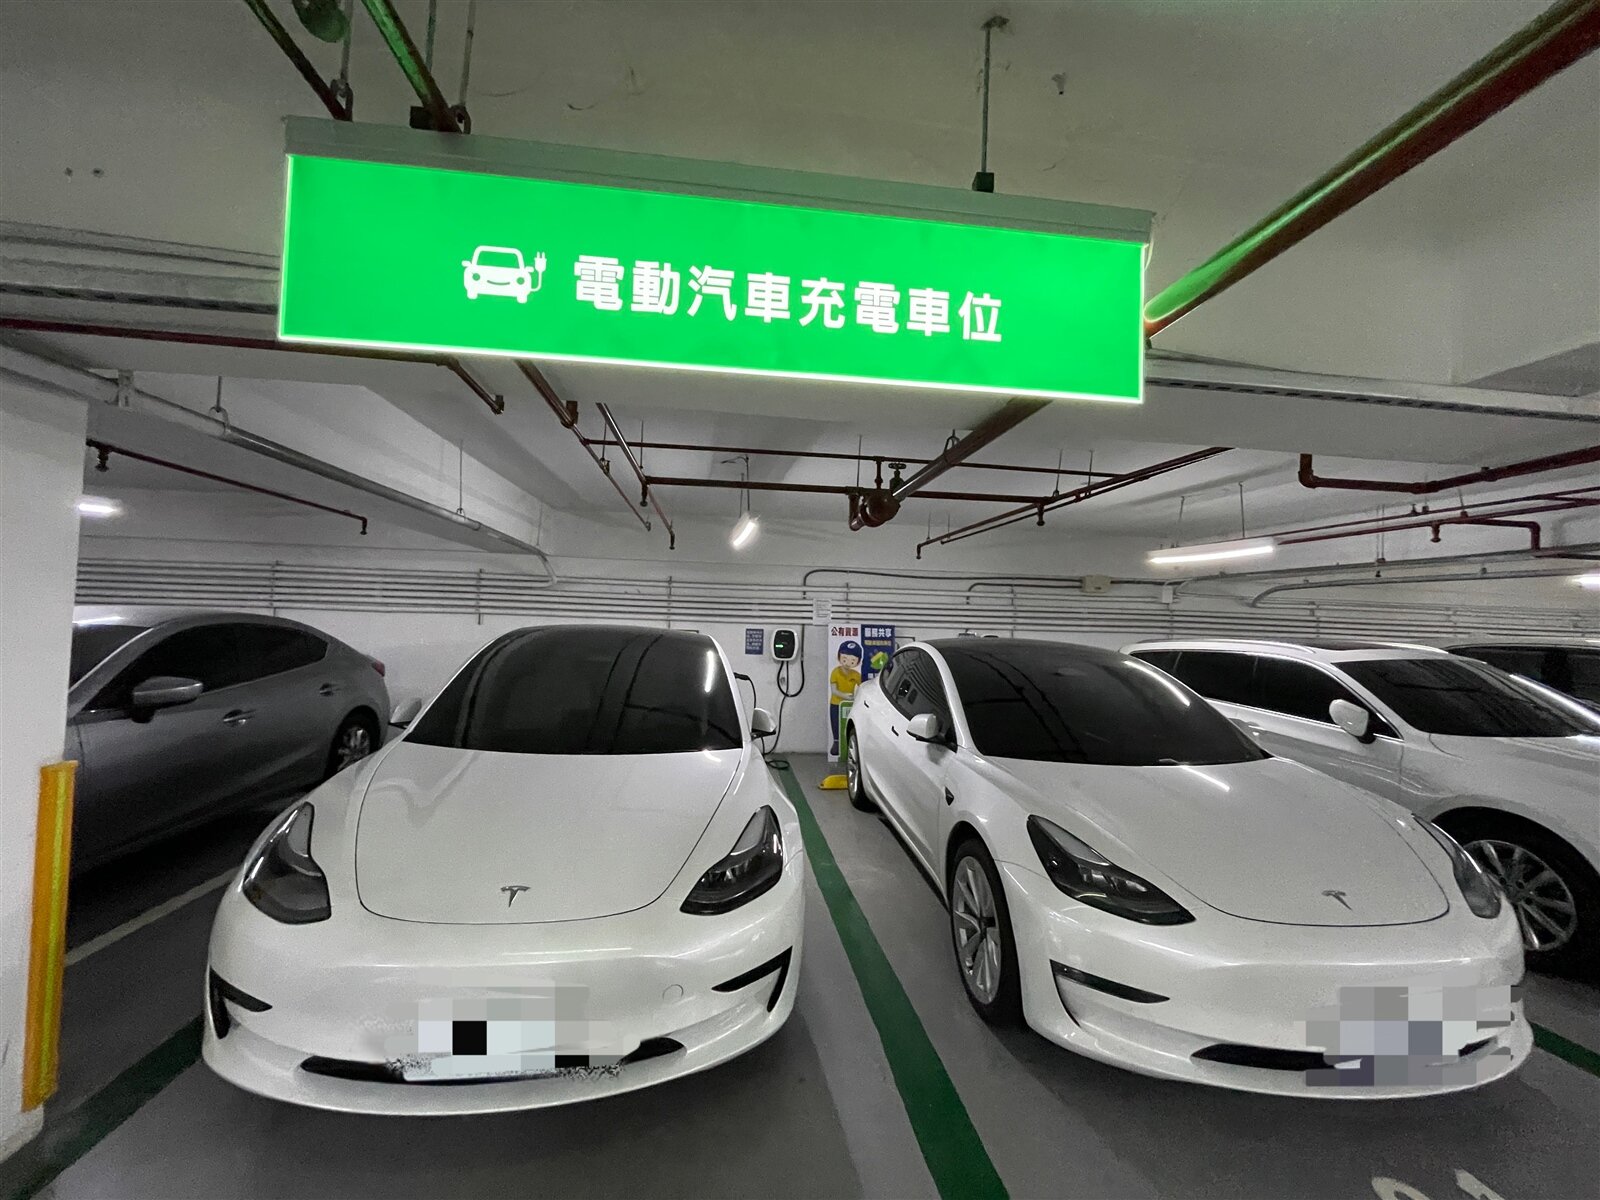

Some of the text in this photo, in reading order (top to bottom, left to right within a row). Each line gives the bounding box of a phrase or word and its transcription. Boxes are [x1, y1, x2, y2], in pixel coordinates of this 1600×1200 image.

[573, 254, 1003, 343] 電動汽車充電車位
